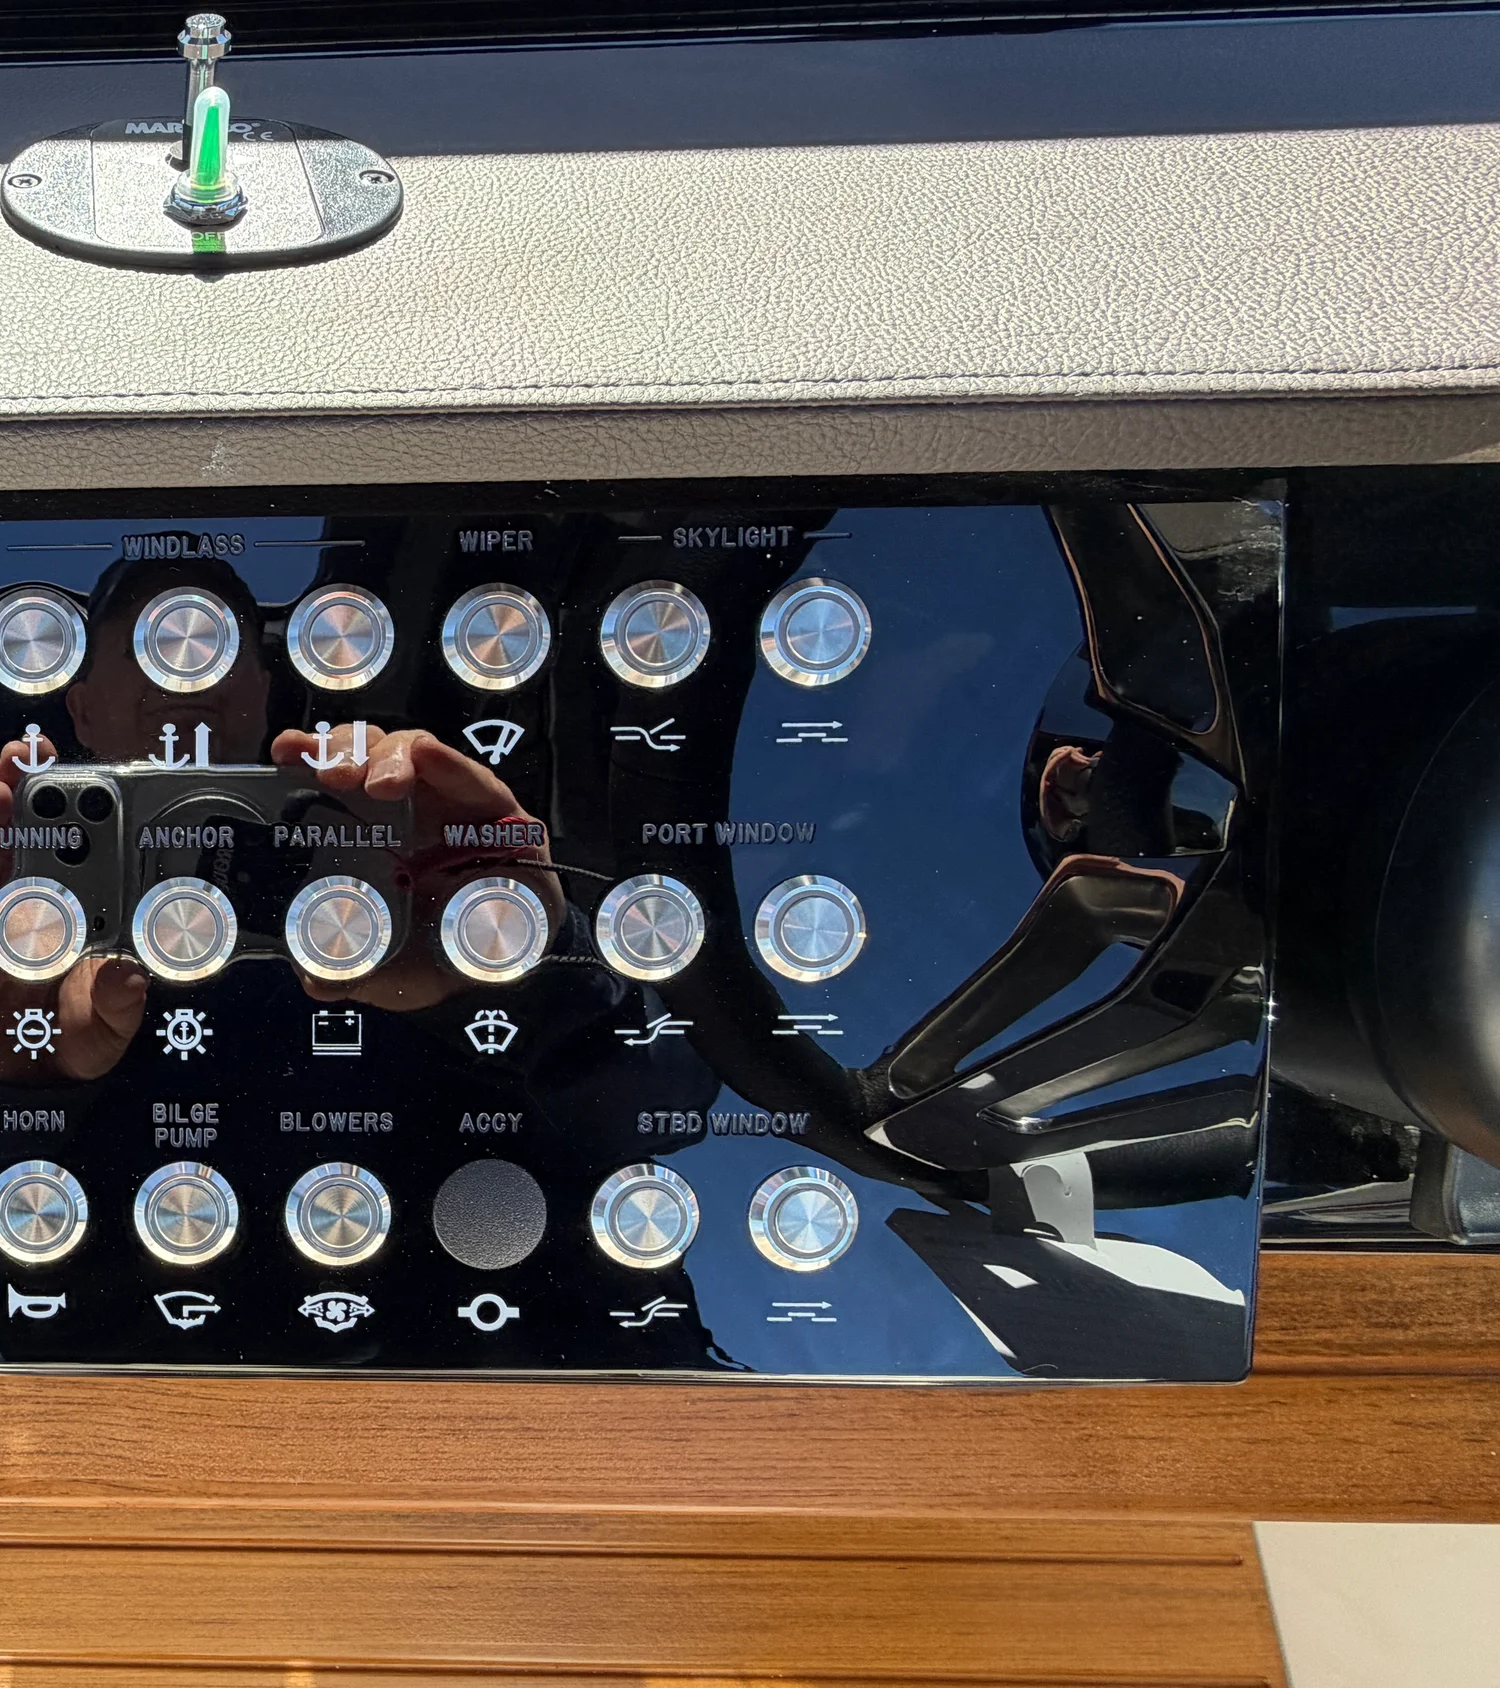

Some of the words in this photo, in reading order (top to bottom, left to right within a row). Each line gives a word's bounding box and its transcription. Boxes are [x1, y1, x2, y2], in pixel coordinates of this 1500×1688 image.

[125, 122, 253, 134] MARO
[122, 533, 245, 560] WINDLASS
[459, 530, 534, 552] WIPER
[672, 526, 793, 548] SKYLIGHT
[138, 825, 235, 849] ANCHOR
[274, 825, 401, 848] PARALLEL
[444, 823, 544, 847] WASHER
[642, 822, 707, 845] PORT
[715, 822, 816, 845] WINDOW
[3, 1110, 65, 1132] HORN
[152, 1103, 220, 1125] BILGE
[280, 1111, 394, 1133] BLOWERS
[459, 1112, 524, 1133] ACCY
[637, 1111, 702, 1134] STBD
[710, 1112, 811, 1135] WINDOW
[155, 1127, 218, 1148] PUMP
